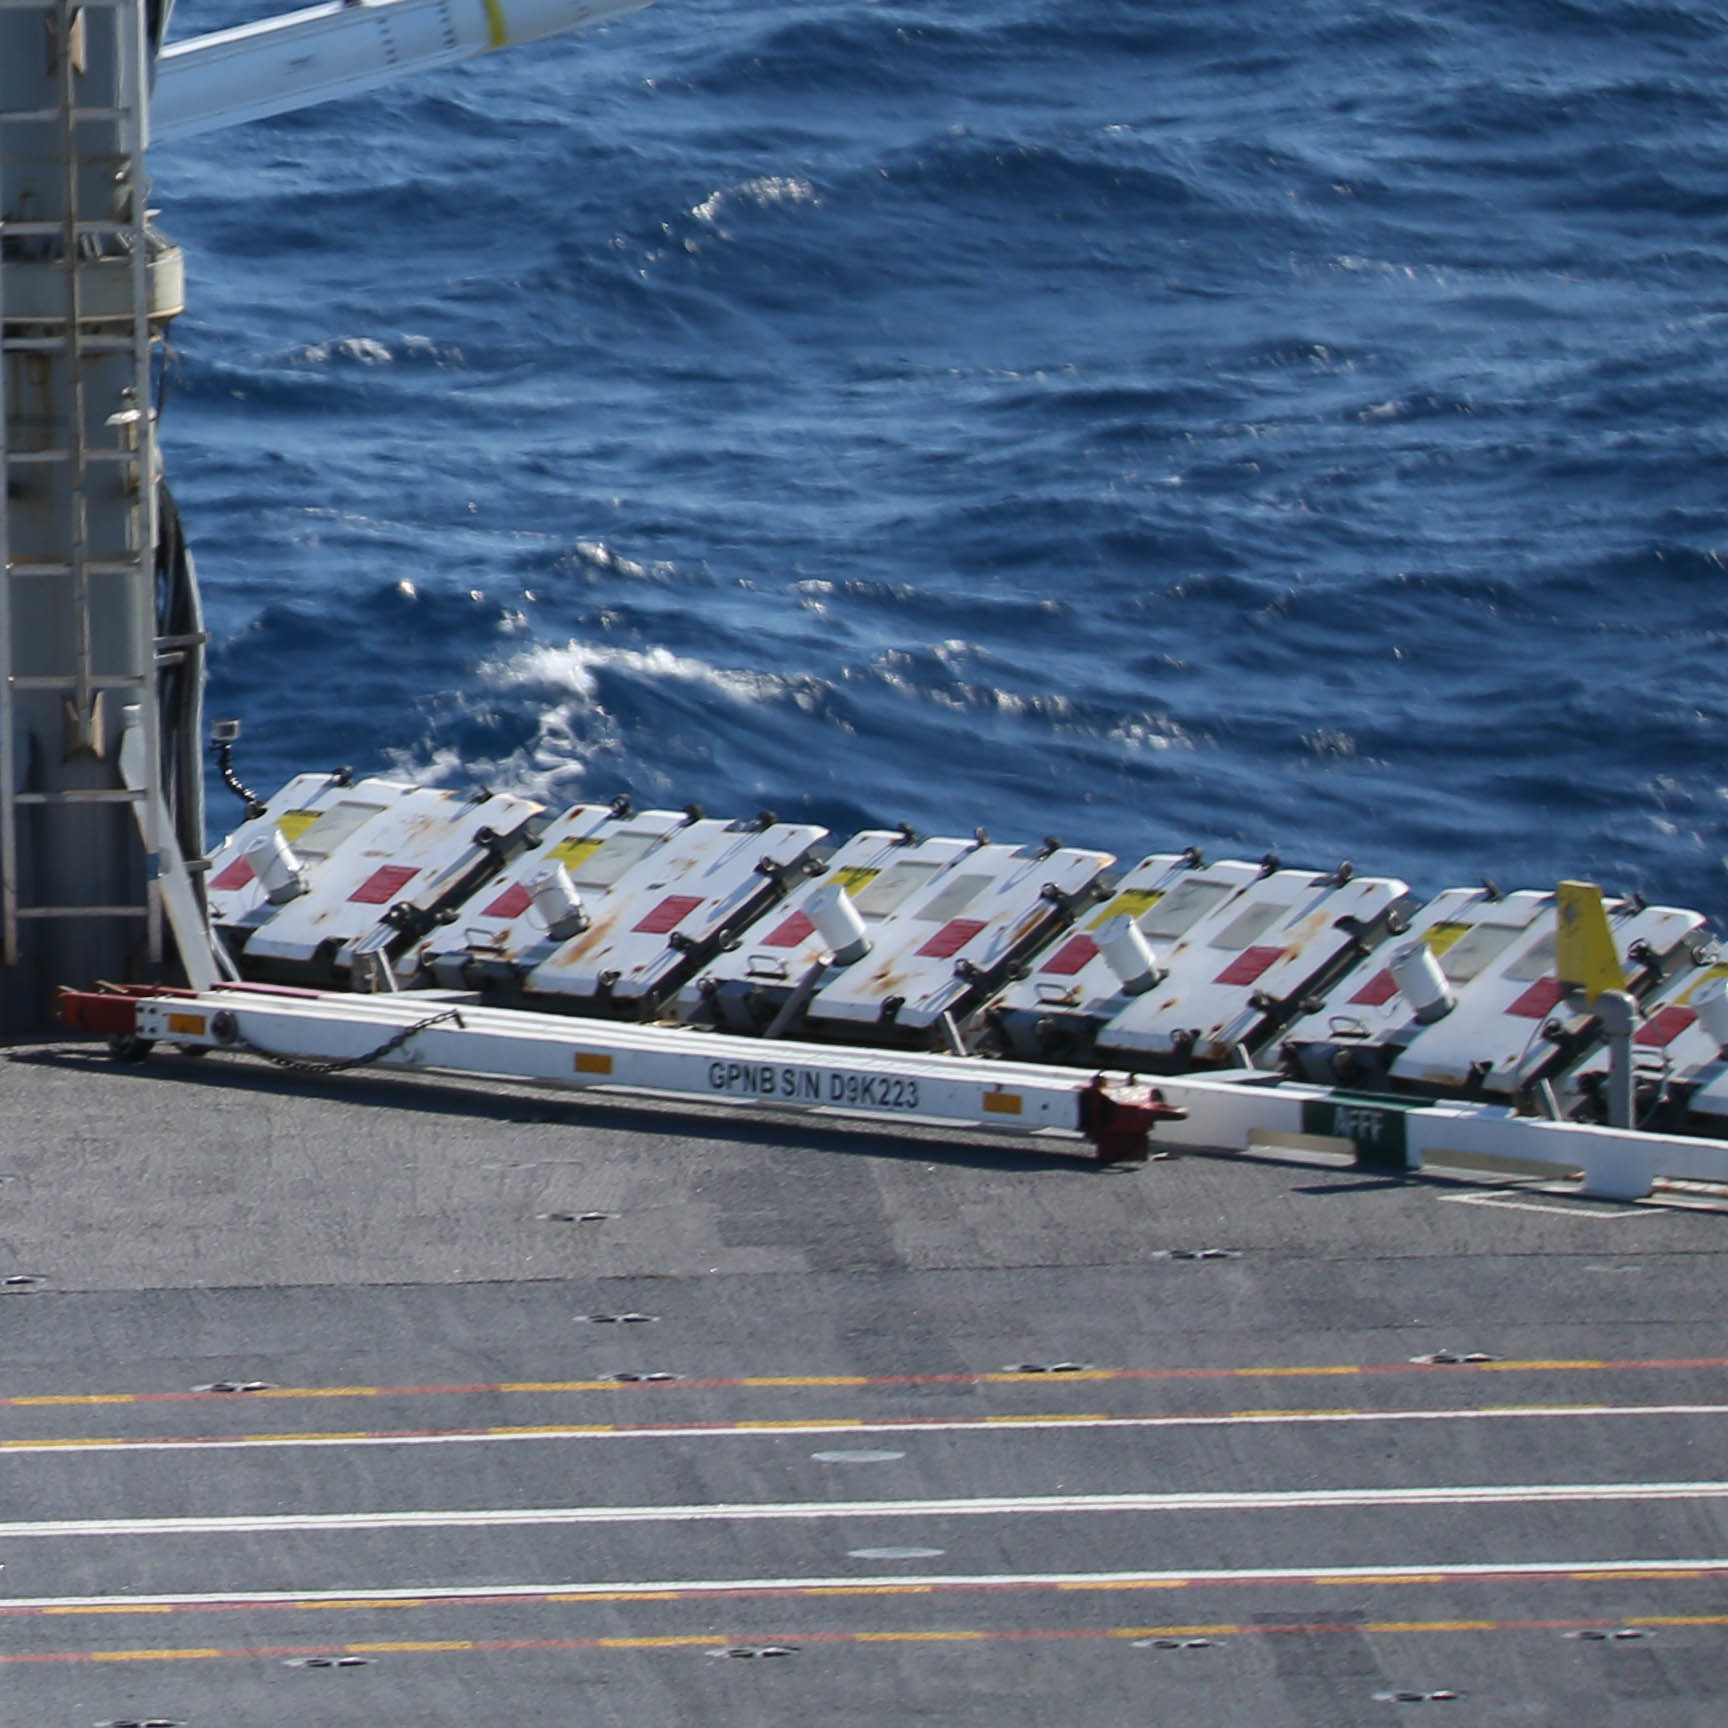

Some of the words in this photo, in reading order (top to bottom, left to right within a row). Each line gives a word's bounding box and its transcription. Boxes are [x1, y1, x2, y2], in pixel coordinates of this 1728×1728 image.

[709, 1062, 776, 1094] GPNB
[781, 1067, 821, 1100] S/N
[830, 1072, 920, 1110] D9K223
[1332, 1105, 1384, 1143] AFFF
